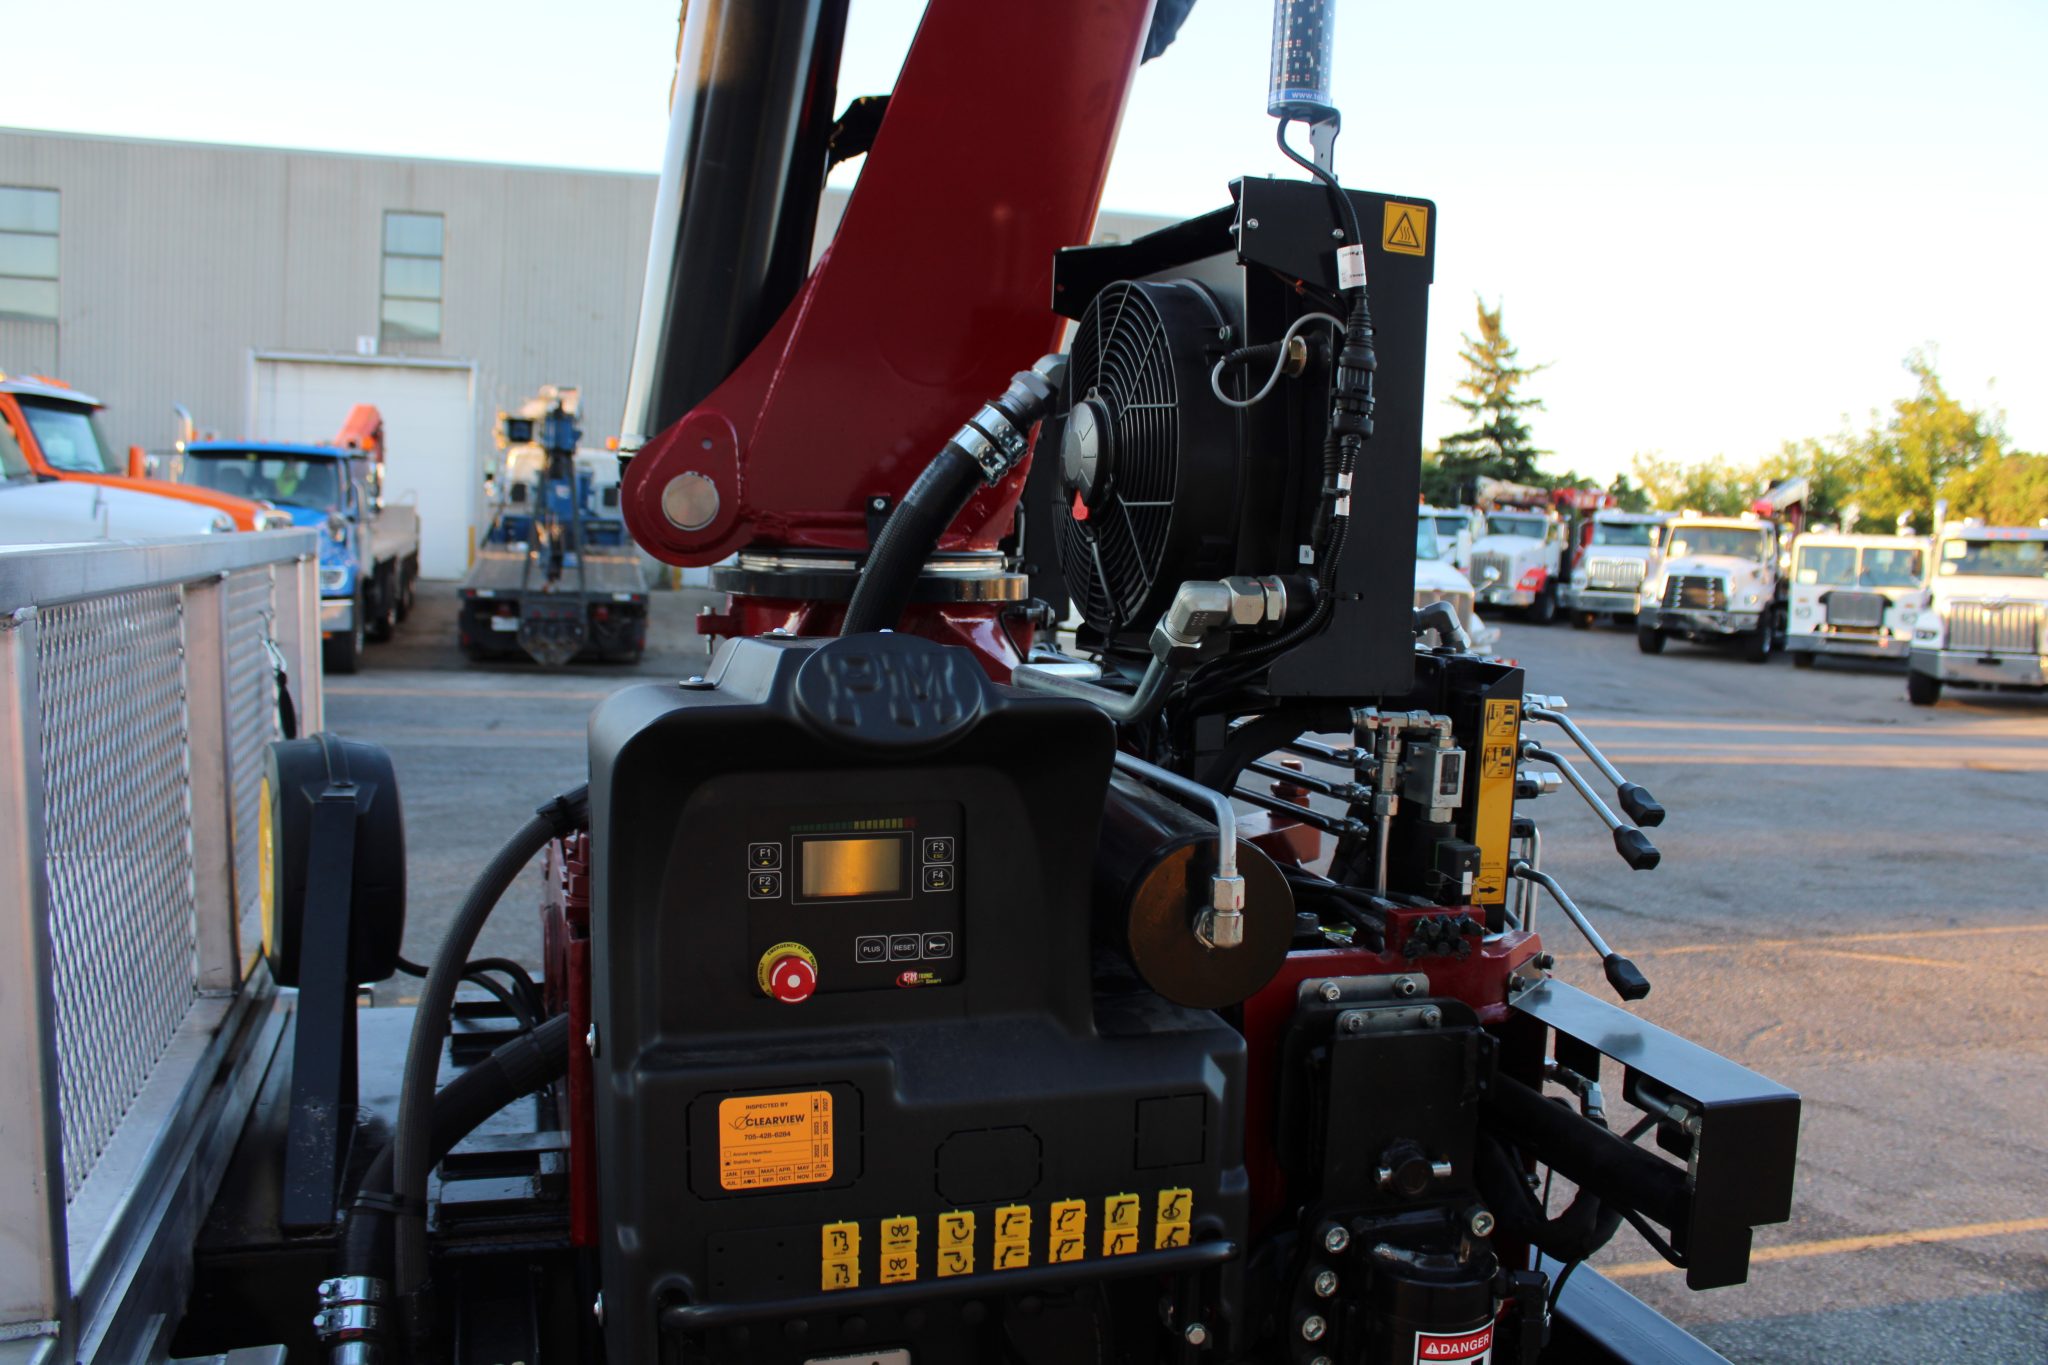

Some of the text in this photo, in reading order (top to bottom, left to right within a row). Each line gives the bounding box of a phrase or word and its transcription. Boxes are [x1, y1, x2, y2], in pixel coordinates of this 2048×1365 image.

[822, 653, 962, 727] PM
[932, 843, 945, 851] F3
[760, 848, 771, 857] F1
[932, 871, 944, 879] F4
[759, 877, 771, 885] F2
[745, 1102, 779, 1110] INSPECTED
[745, 1114, 805, 1126] CLEARVIEW
[1440, 1334, 1490, 1355] DANGER
